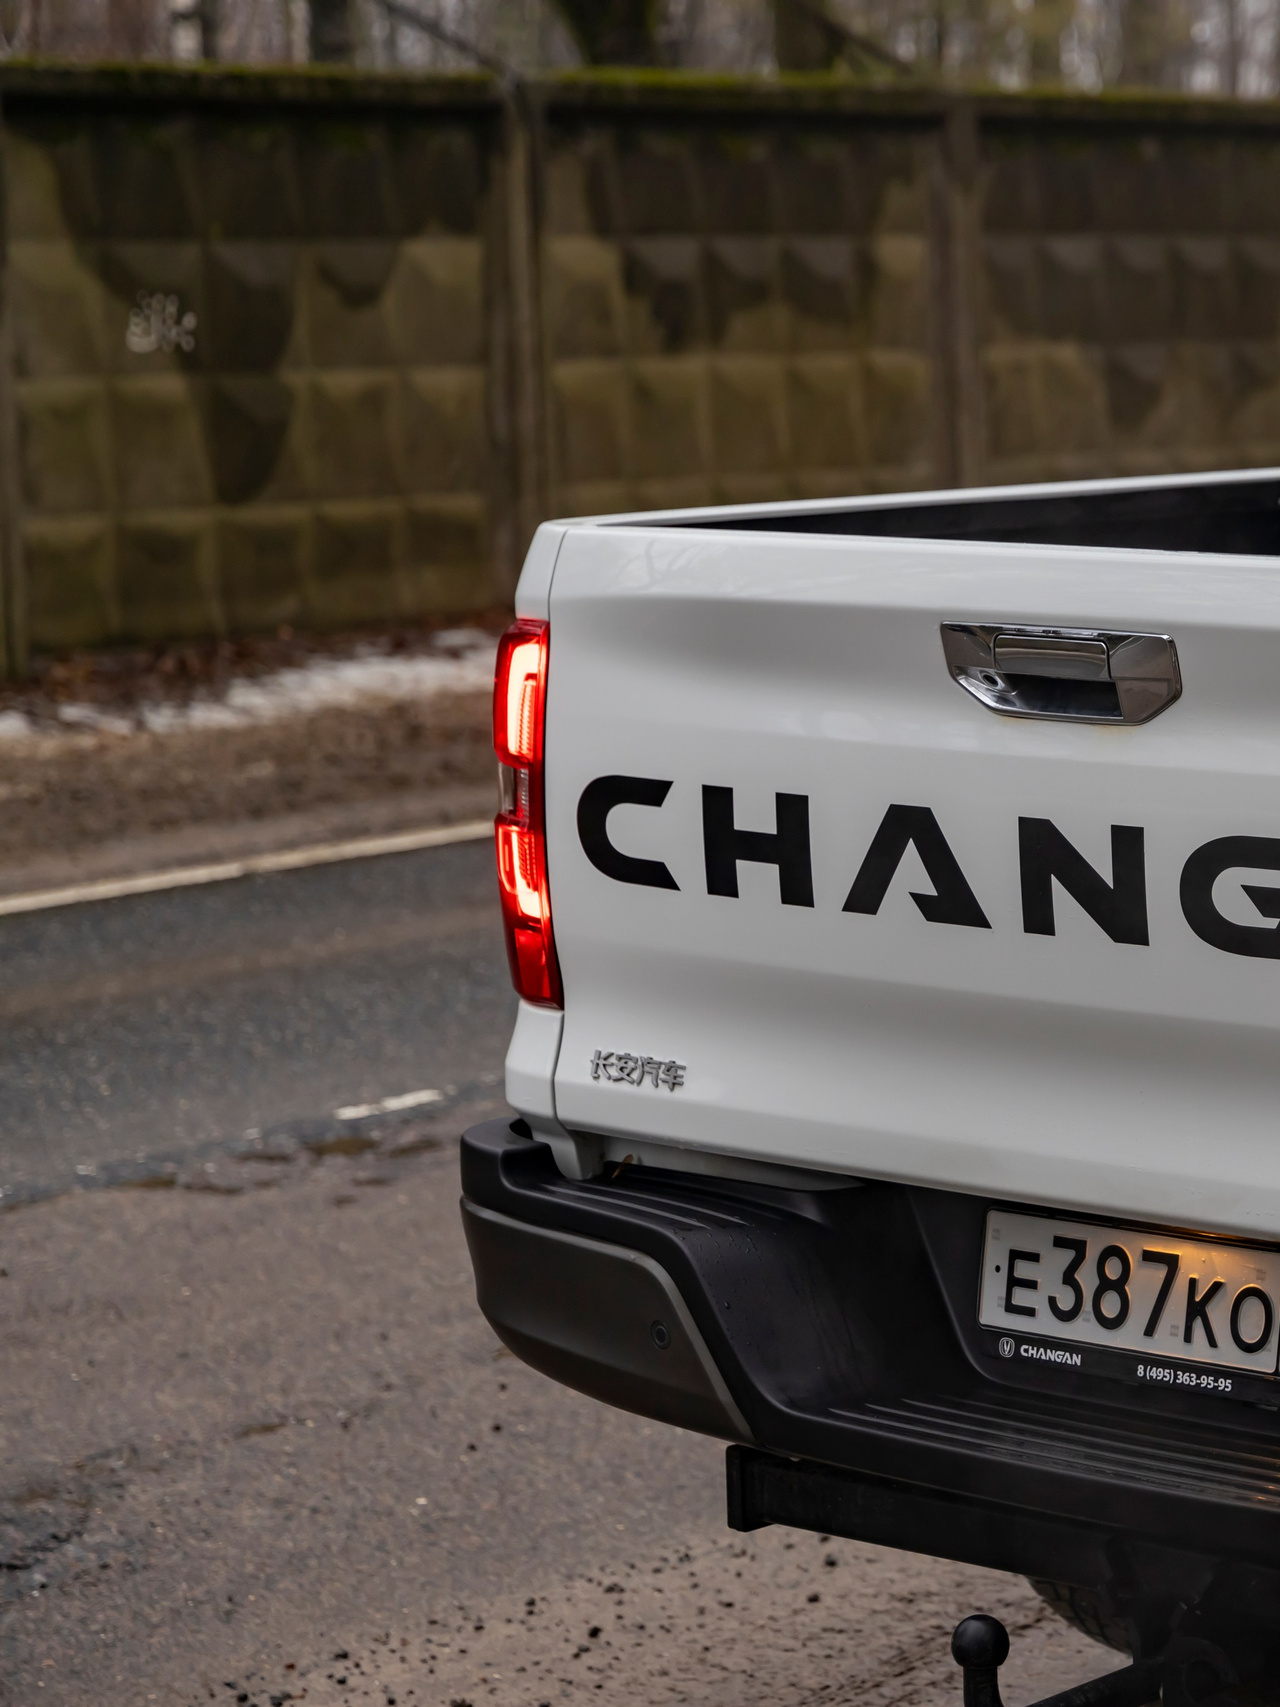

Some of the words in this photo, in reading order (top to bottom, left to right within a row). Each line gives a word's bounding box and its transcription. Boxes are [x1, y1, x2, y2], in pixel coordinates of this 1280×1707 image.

[590, 1049, 687, 1091] 长安汽车
[1020, 1344, 1082, 1366] CHANGAN
[1137, 1364, 1145, 1377] 8
[1146, 1366, 1174, 1384] (495)
[1175, 1371, 1232, 1392] 363-95-95
